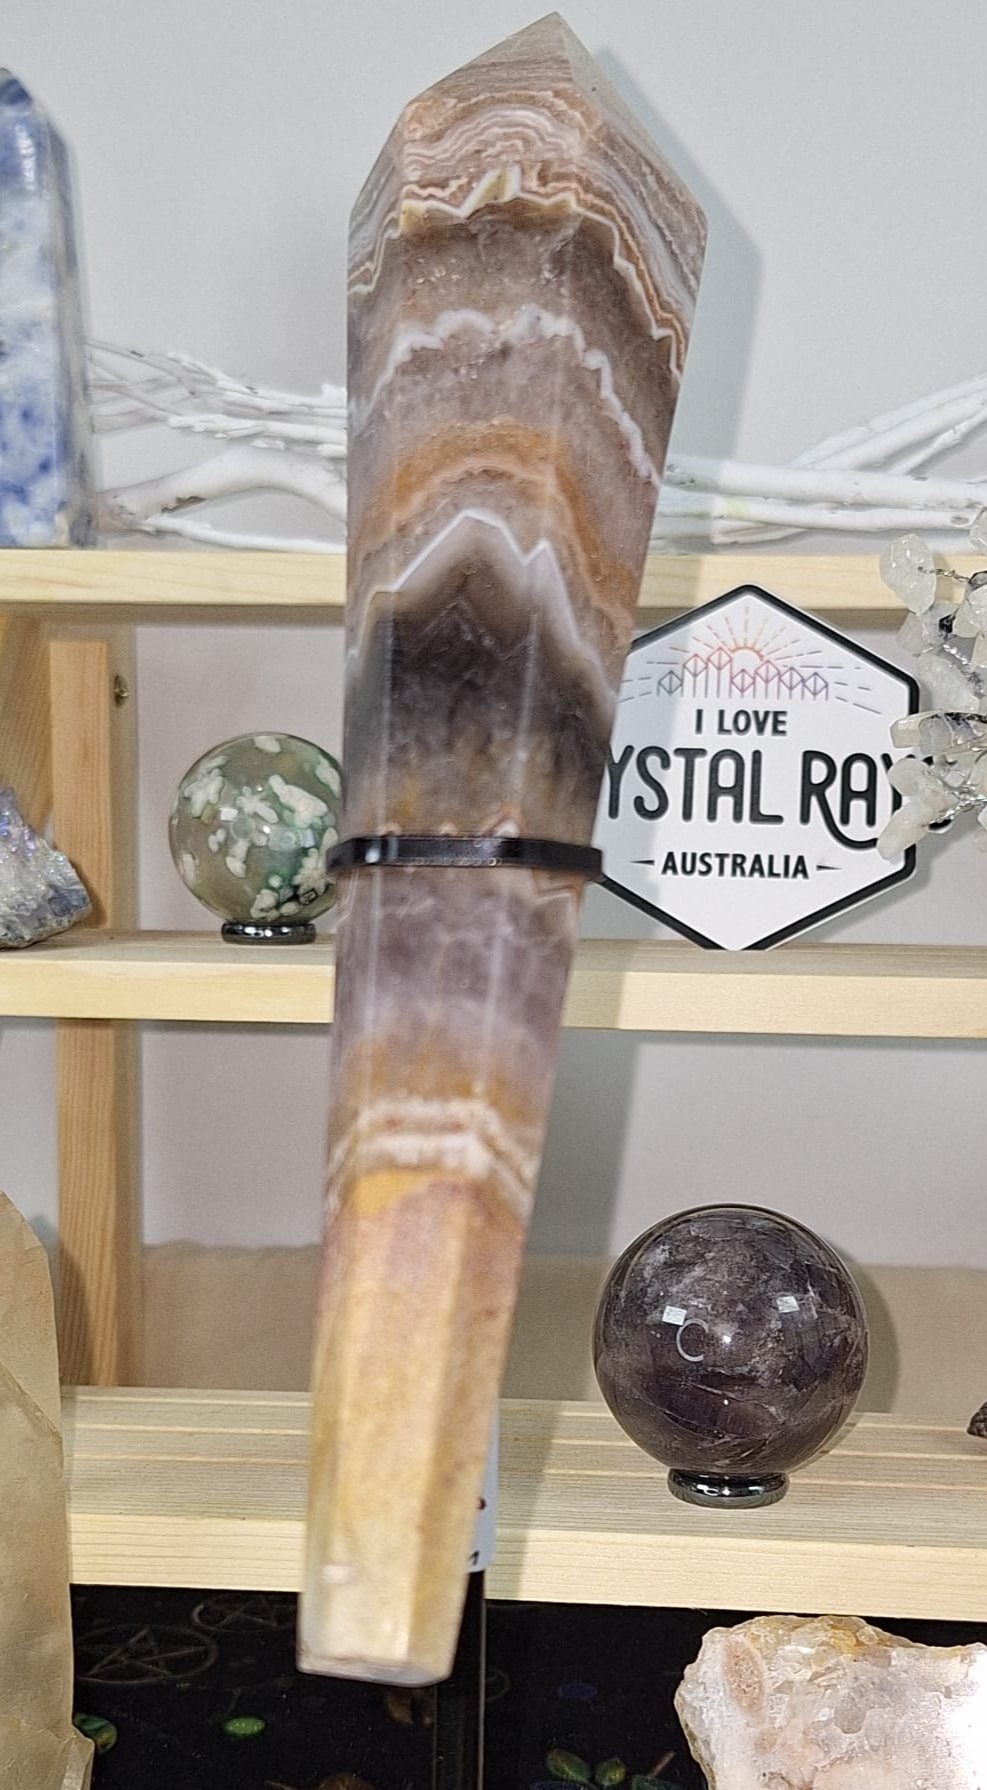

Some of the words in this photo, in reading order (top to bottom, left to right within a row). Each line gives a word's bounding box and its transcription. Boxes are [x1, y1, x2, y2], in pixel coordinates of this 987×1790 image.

[695, 708, 704, 735] I
[717, 709, 788, 736] LOVE
[607, 744, 784, 825] YSTAL
[661, 851, 810, 880] AUSTRALIA
